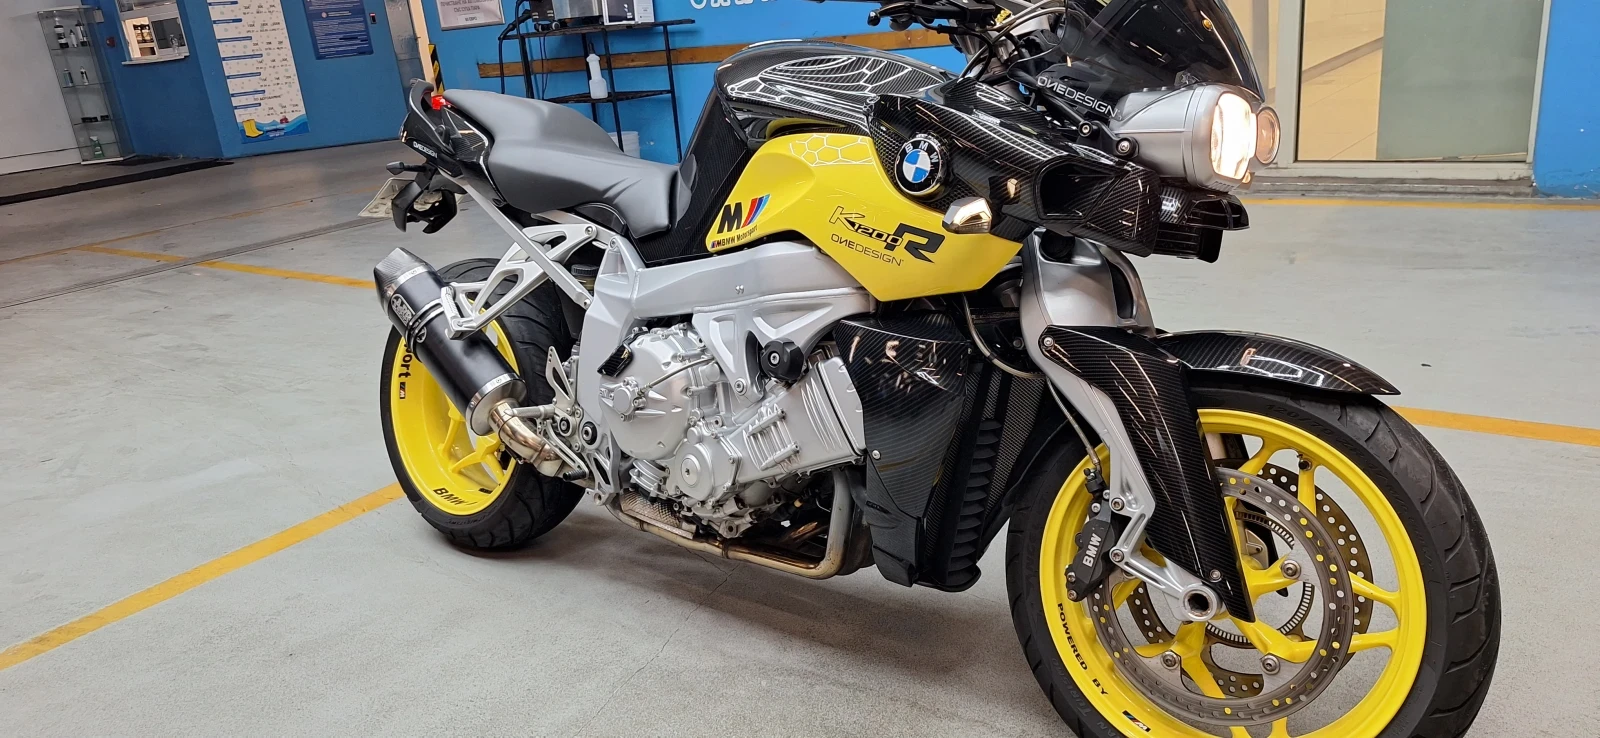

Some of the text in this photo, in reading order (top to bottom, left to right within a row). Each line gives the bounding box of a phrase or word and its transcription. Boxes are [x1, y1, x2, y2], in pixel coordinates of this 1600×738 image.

[1037, 76, 1118, 118] ONEDESIGN
[904, 140, 939, 163] BMW
[717, 201, 743, 235] M
[736, 224, 758, 242] Motorsport
[830, 233, 902, 267] ONEDESIGN
[432, 487, 466, 506] BMW
[1082, 532, 1102, 568] BMW
[1057, 602, 1088, 671] POWERED
[1092, 678, 1108, 695] BY
